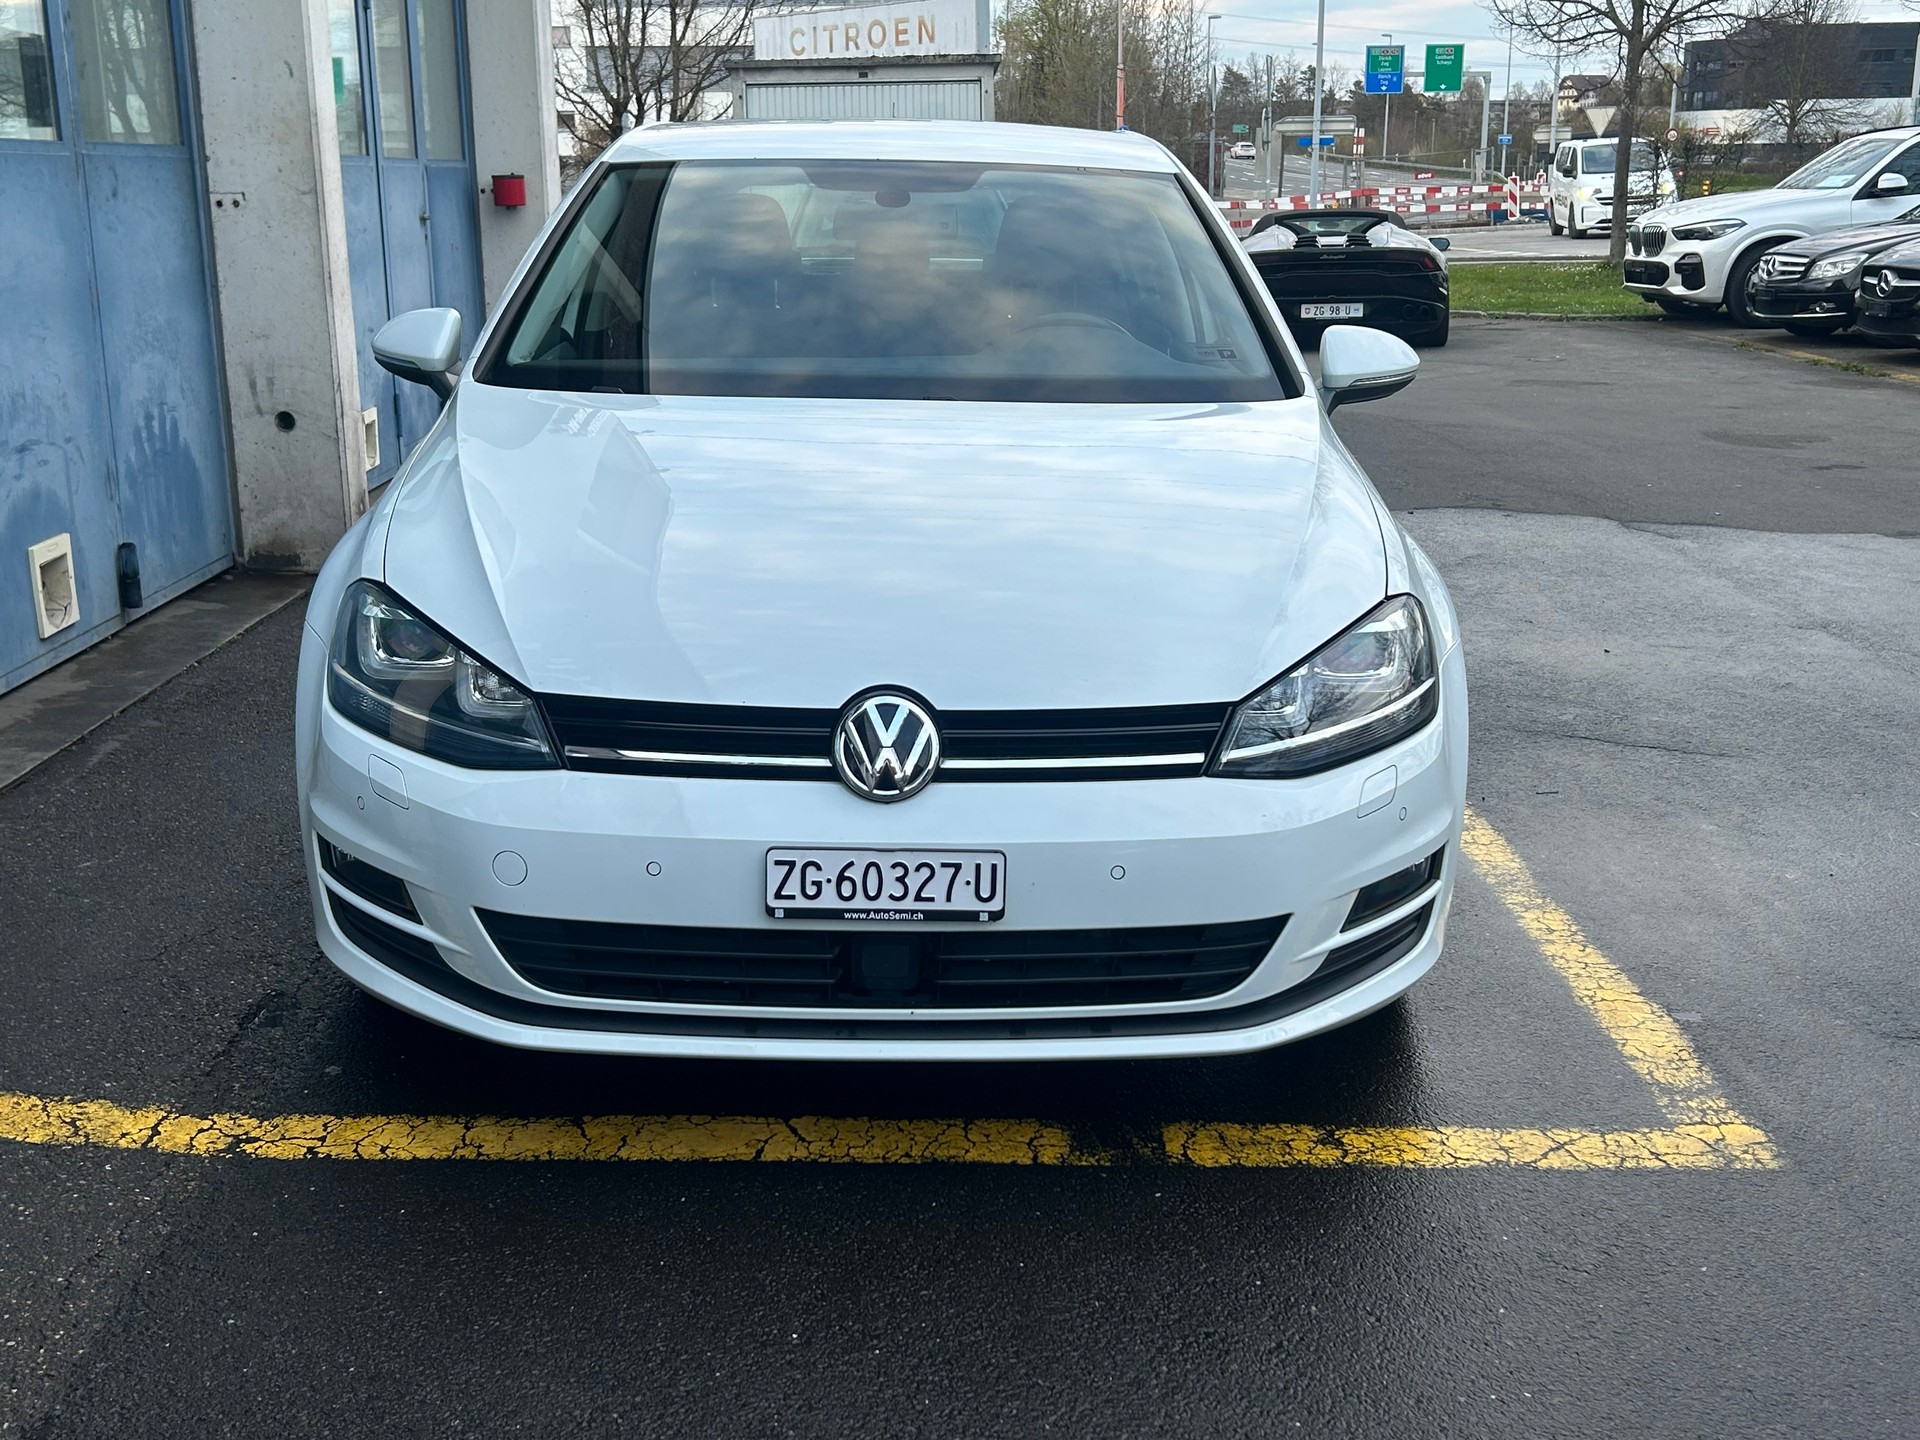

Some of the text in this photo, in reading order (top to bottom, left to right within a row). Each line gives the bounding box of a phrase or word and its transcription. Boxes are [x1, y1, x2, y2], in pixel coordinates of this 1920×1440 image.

[790, 15, 935, 56] CITROEN
[1313, 306, 1325, 316] ZG
[1329, 305, 1341, 316] 98
[843, 910, 924, 921] www.AutoSemi.ch
